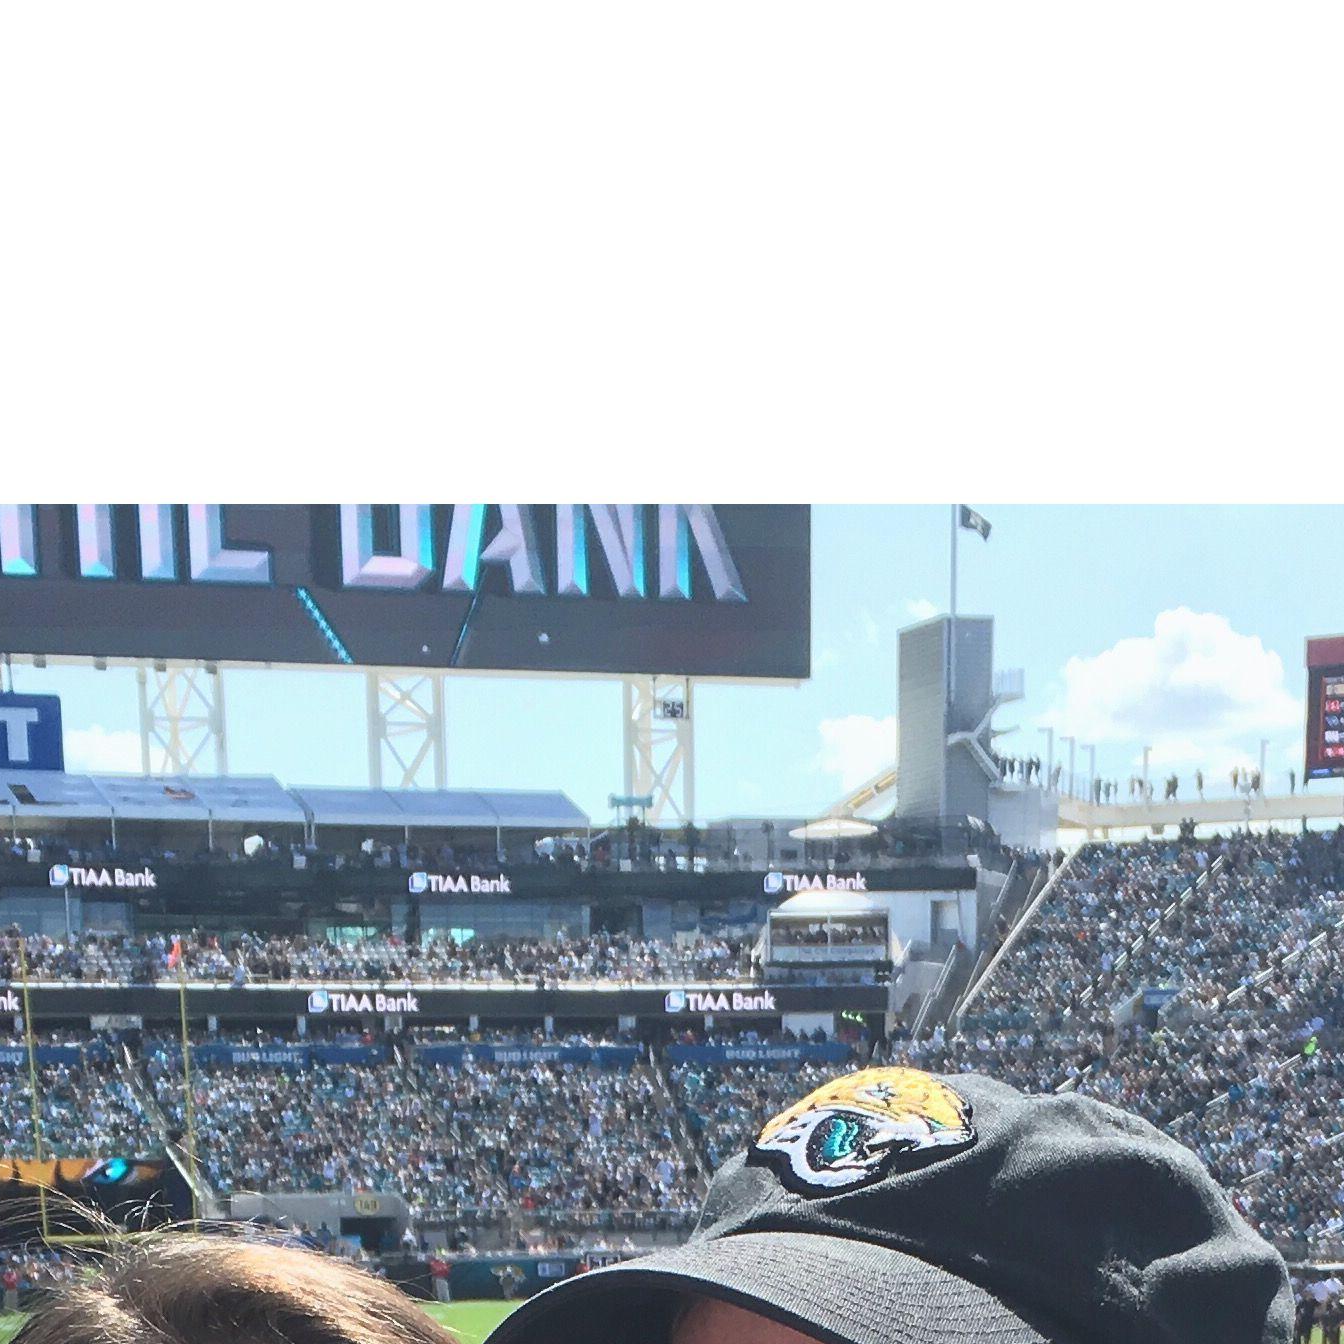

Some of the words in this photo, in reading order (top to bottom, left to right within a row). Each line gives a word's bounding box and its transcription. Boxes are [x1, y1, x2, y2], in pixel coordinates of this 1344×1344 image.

[69, 867, 113, 887] TIAA
[115, 867, 158, 888] Bank
[428, 873, 469, 893] TIAA
[470, 873, 512, 893] Bank
[783, 873, 825, 891] TIAA
[826, 872, 868, 891] Bank
[328, 992, 373, 1013] TIAA
[375, 991, 420, 1013] Bank
[685, 992, 730, 1012] TIAA
[732, 990, 776, 1012] Bank
